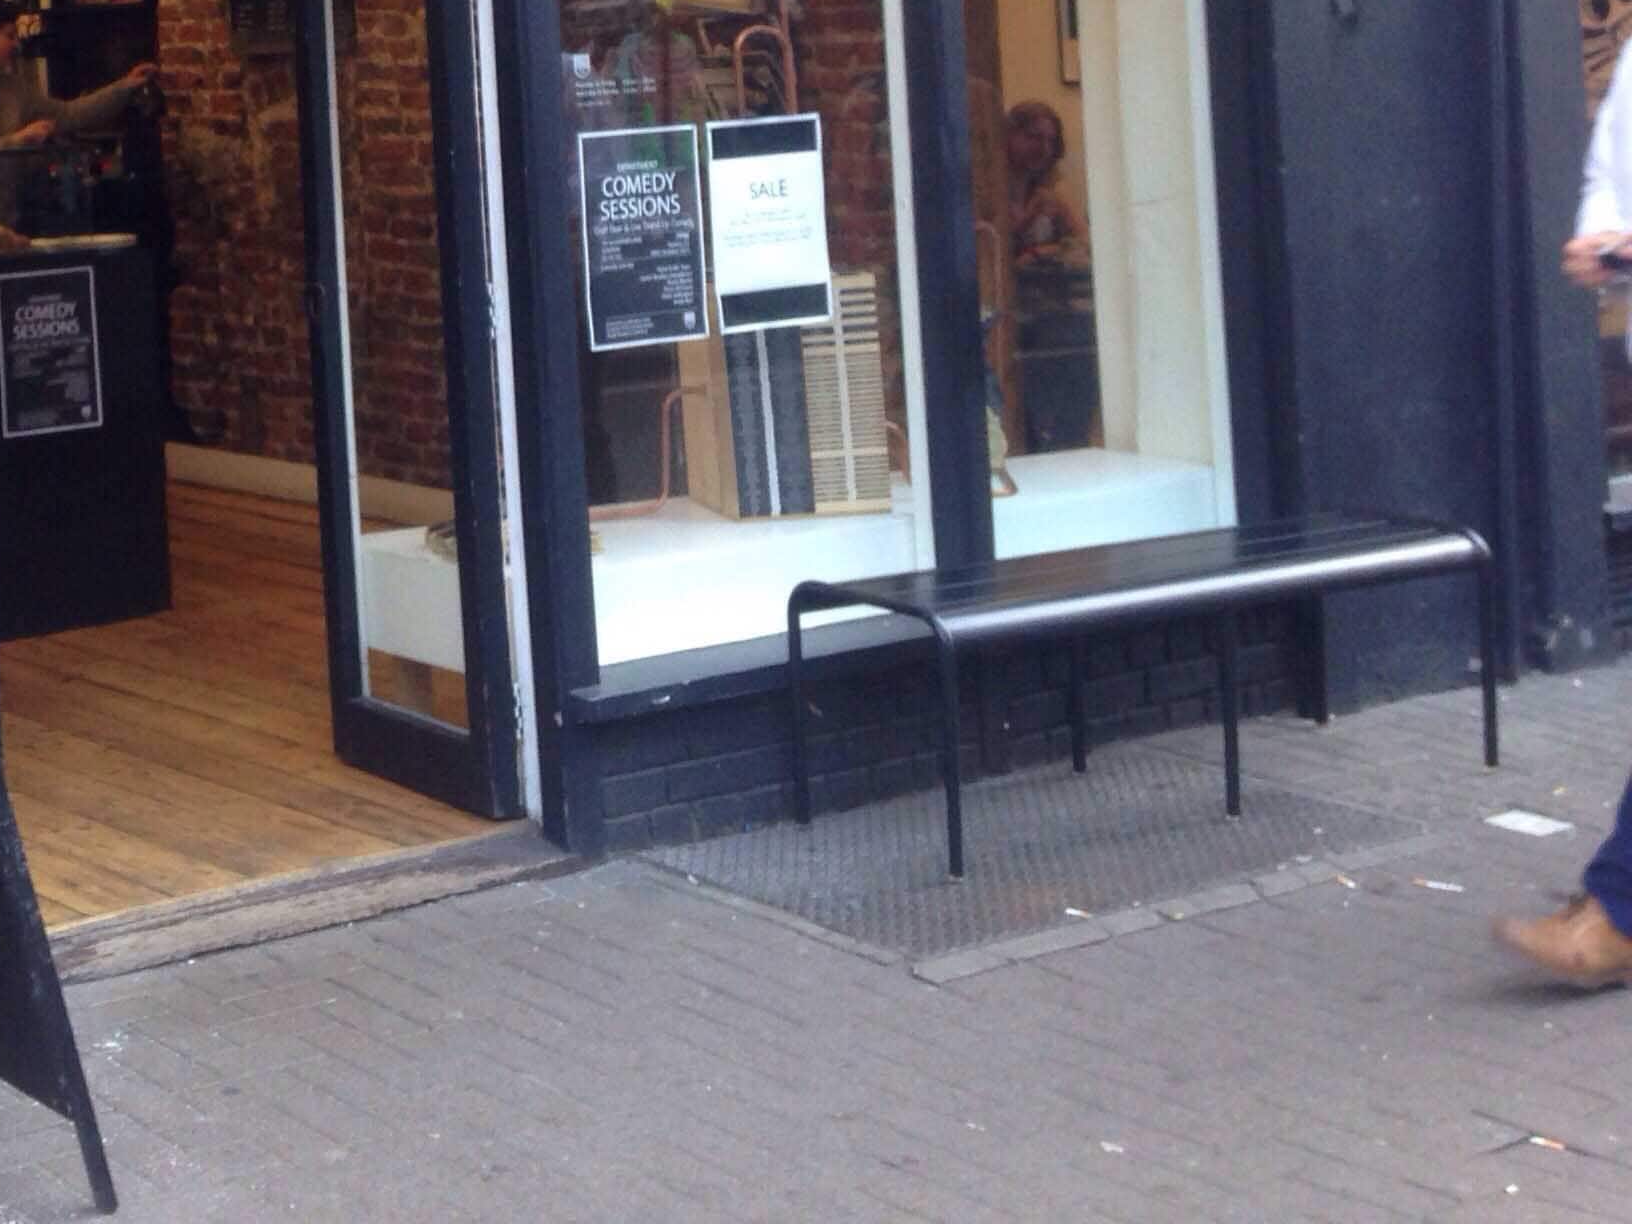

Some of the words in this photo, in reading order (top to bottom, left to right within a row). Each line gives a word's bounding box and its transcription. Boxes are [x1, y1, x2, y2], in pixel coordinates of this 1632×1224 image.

[601, 171, 676, 198] COMEDY
[749, 178, 789, 200] SALE
[600, 193, 681, 221] SESSIONS
